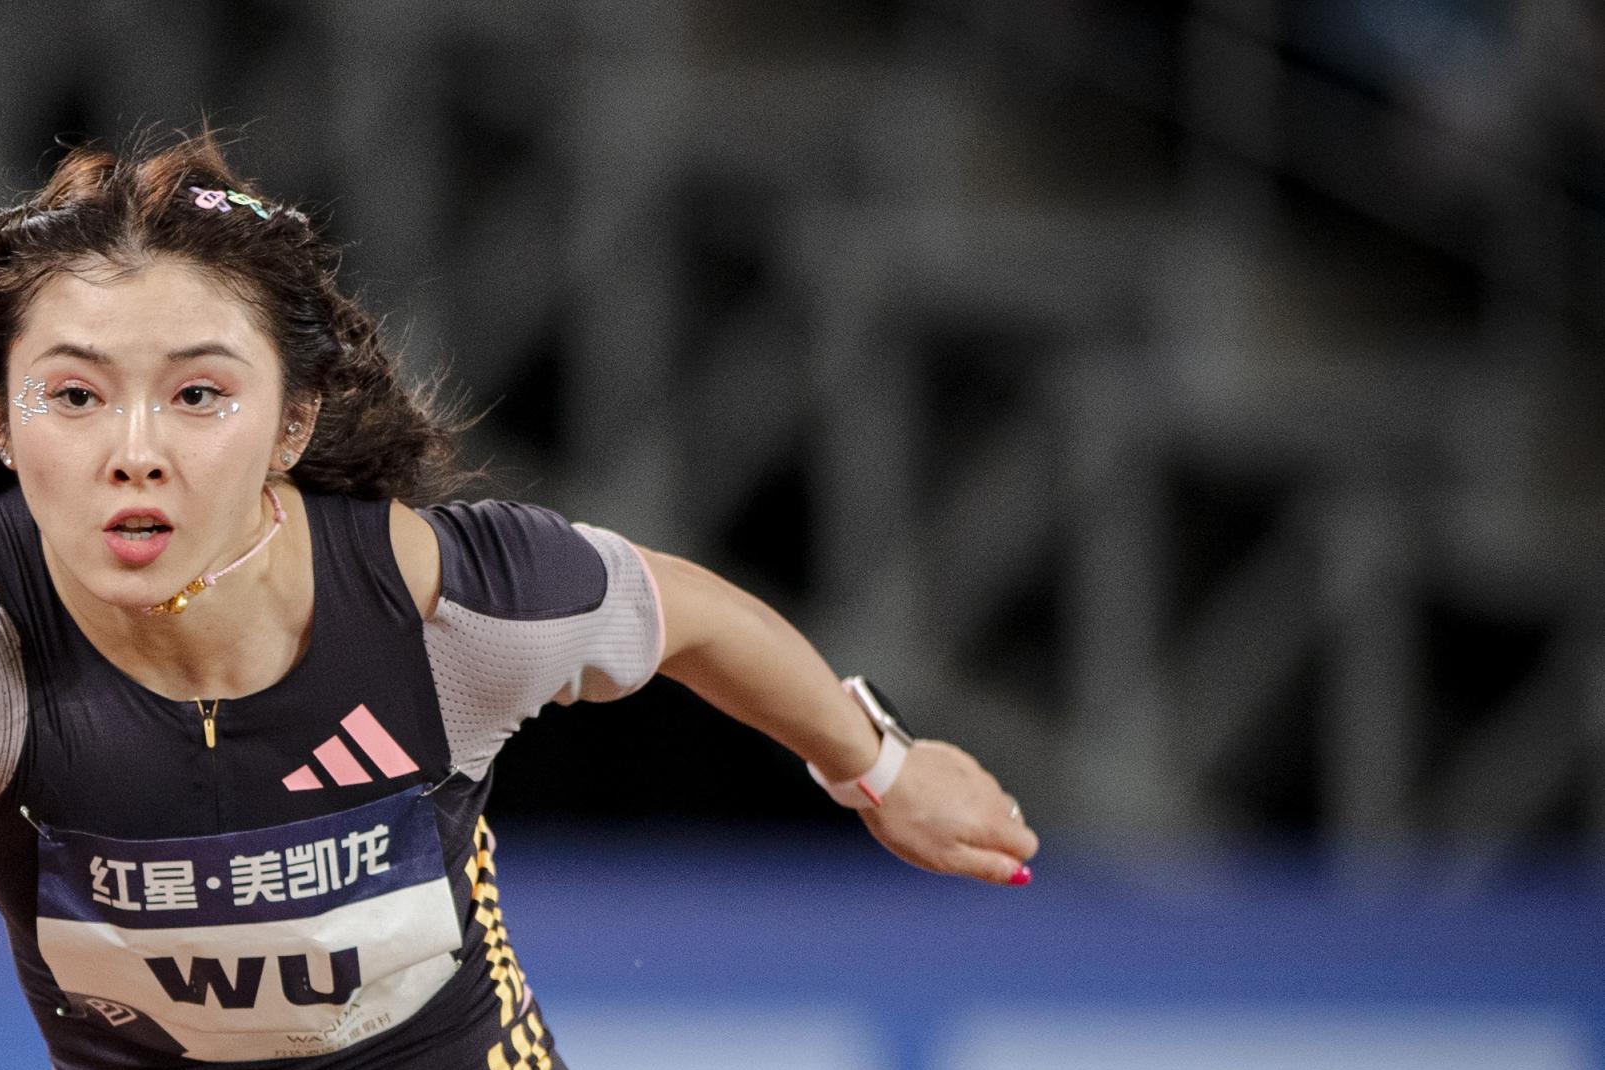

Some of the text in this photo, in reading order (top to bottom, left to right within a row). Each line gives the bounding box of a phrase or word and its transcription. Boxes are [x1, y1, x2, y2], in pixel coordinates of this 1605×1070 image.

[89, 823, 391, 912] 红星·美凯龙
[145, 947, 362, 1009] WU
